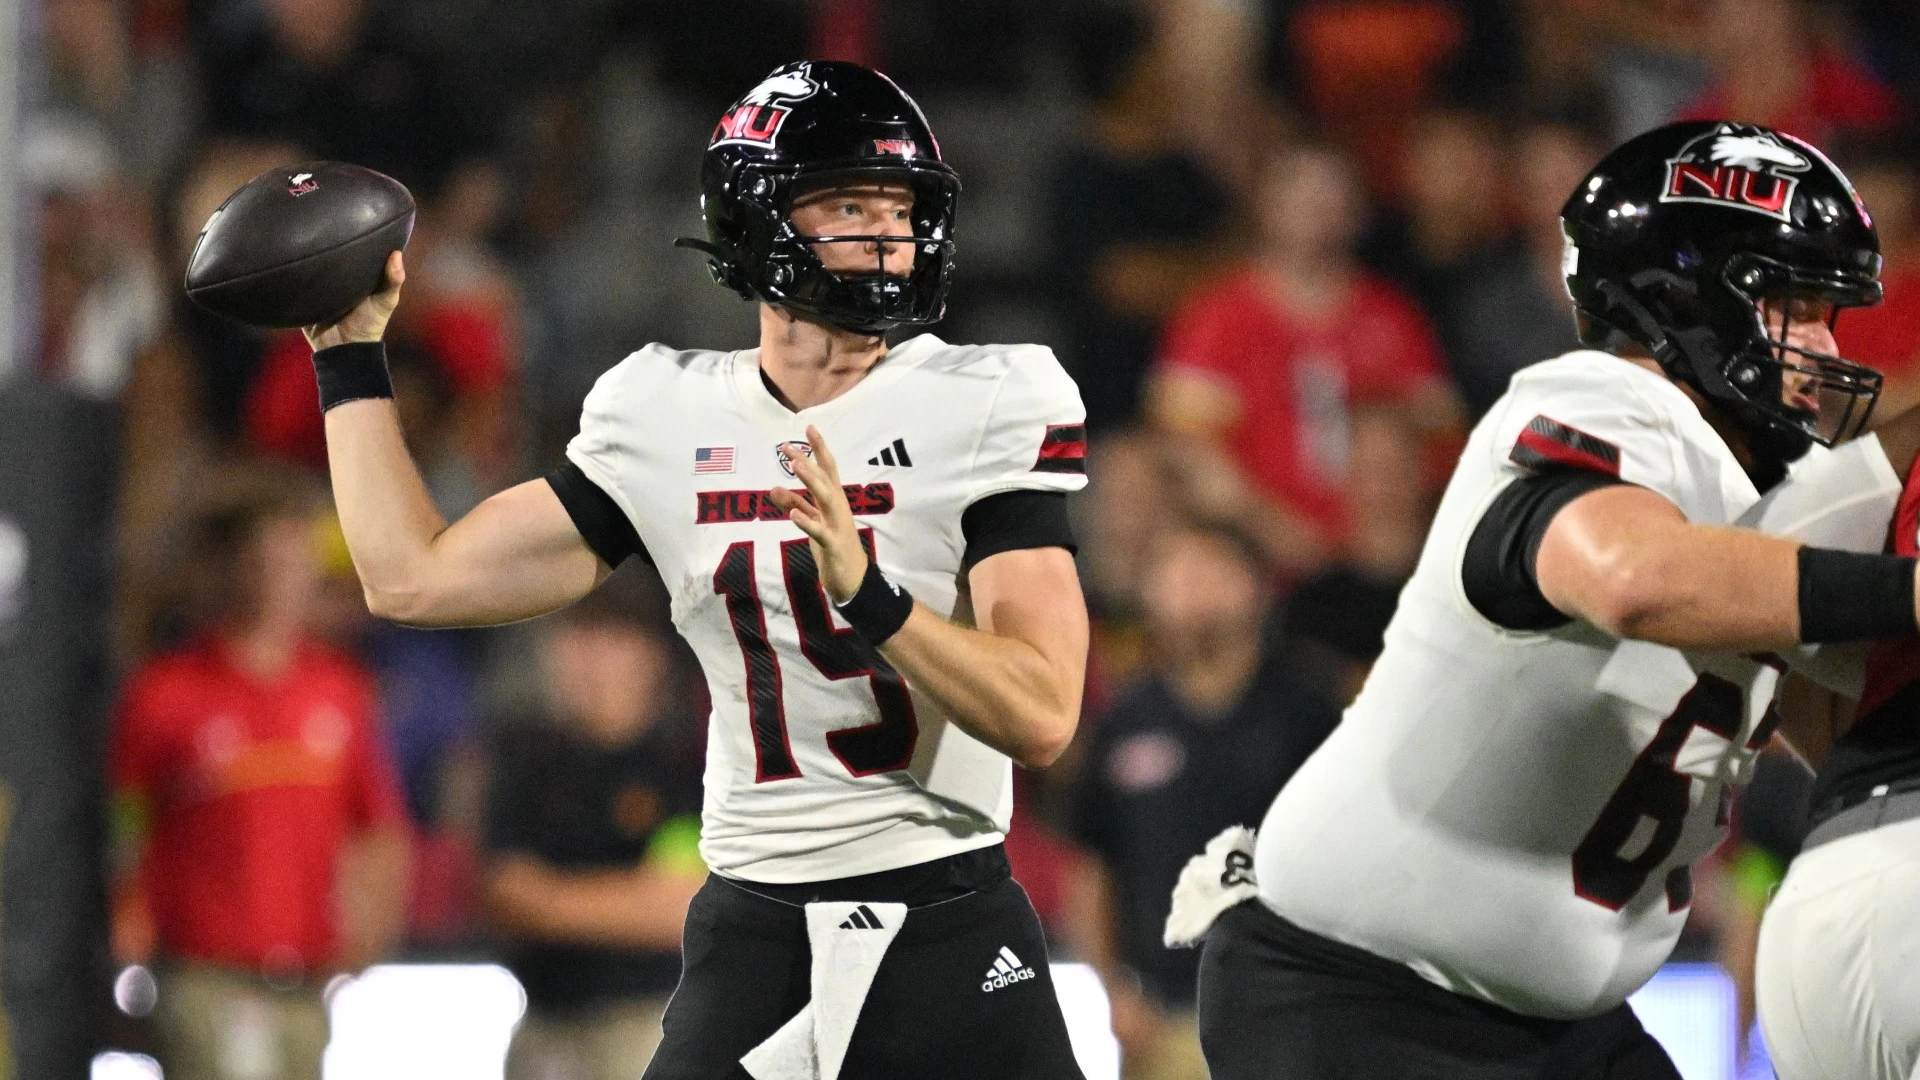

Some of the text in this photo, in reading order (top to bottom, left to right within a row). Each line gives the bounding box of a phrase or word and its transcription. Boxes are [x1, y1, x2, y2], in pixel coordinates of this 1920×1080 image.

[711, 105, 783, 143] NIU
[873, 139, 916, 160] NIU
[1670, 162, 1791, 212] NIU
[694, 482, 895, 524] HUSES
[713, 528, 919, 783] 15
[981, 967, 1036, 992] adidas
